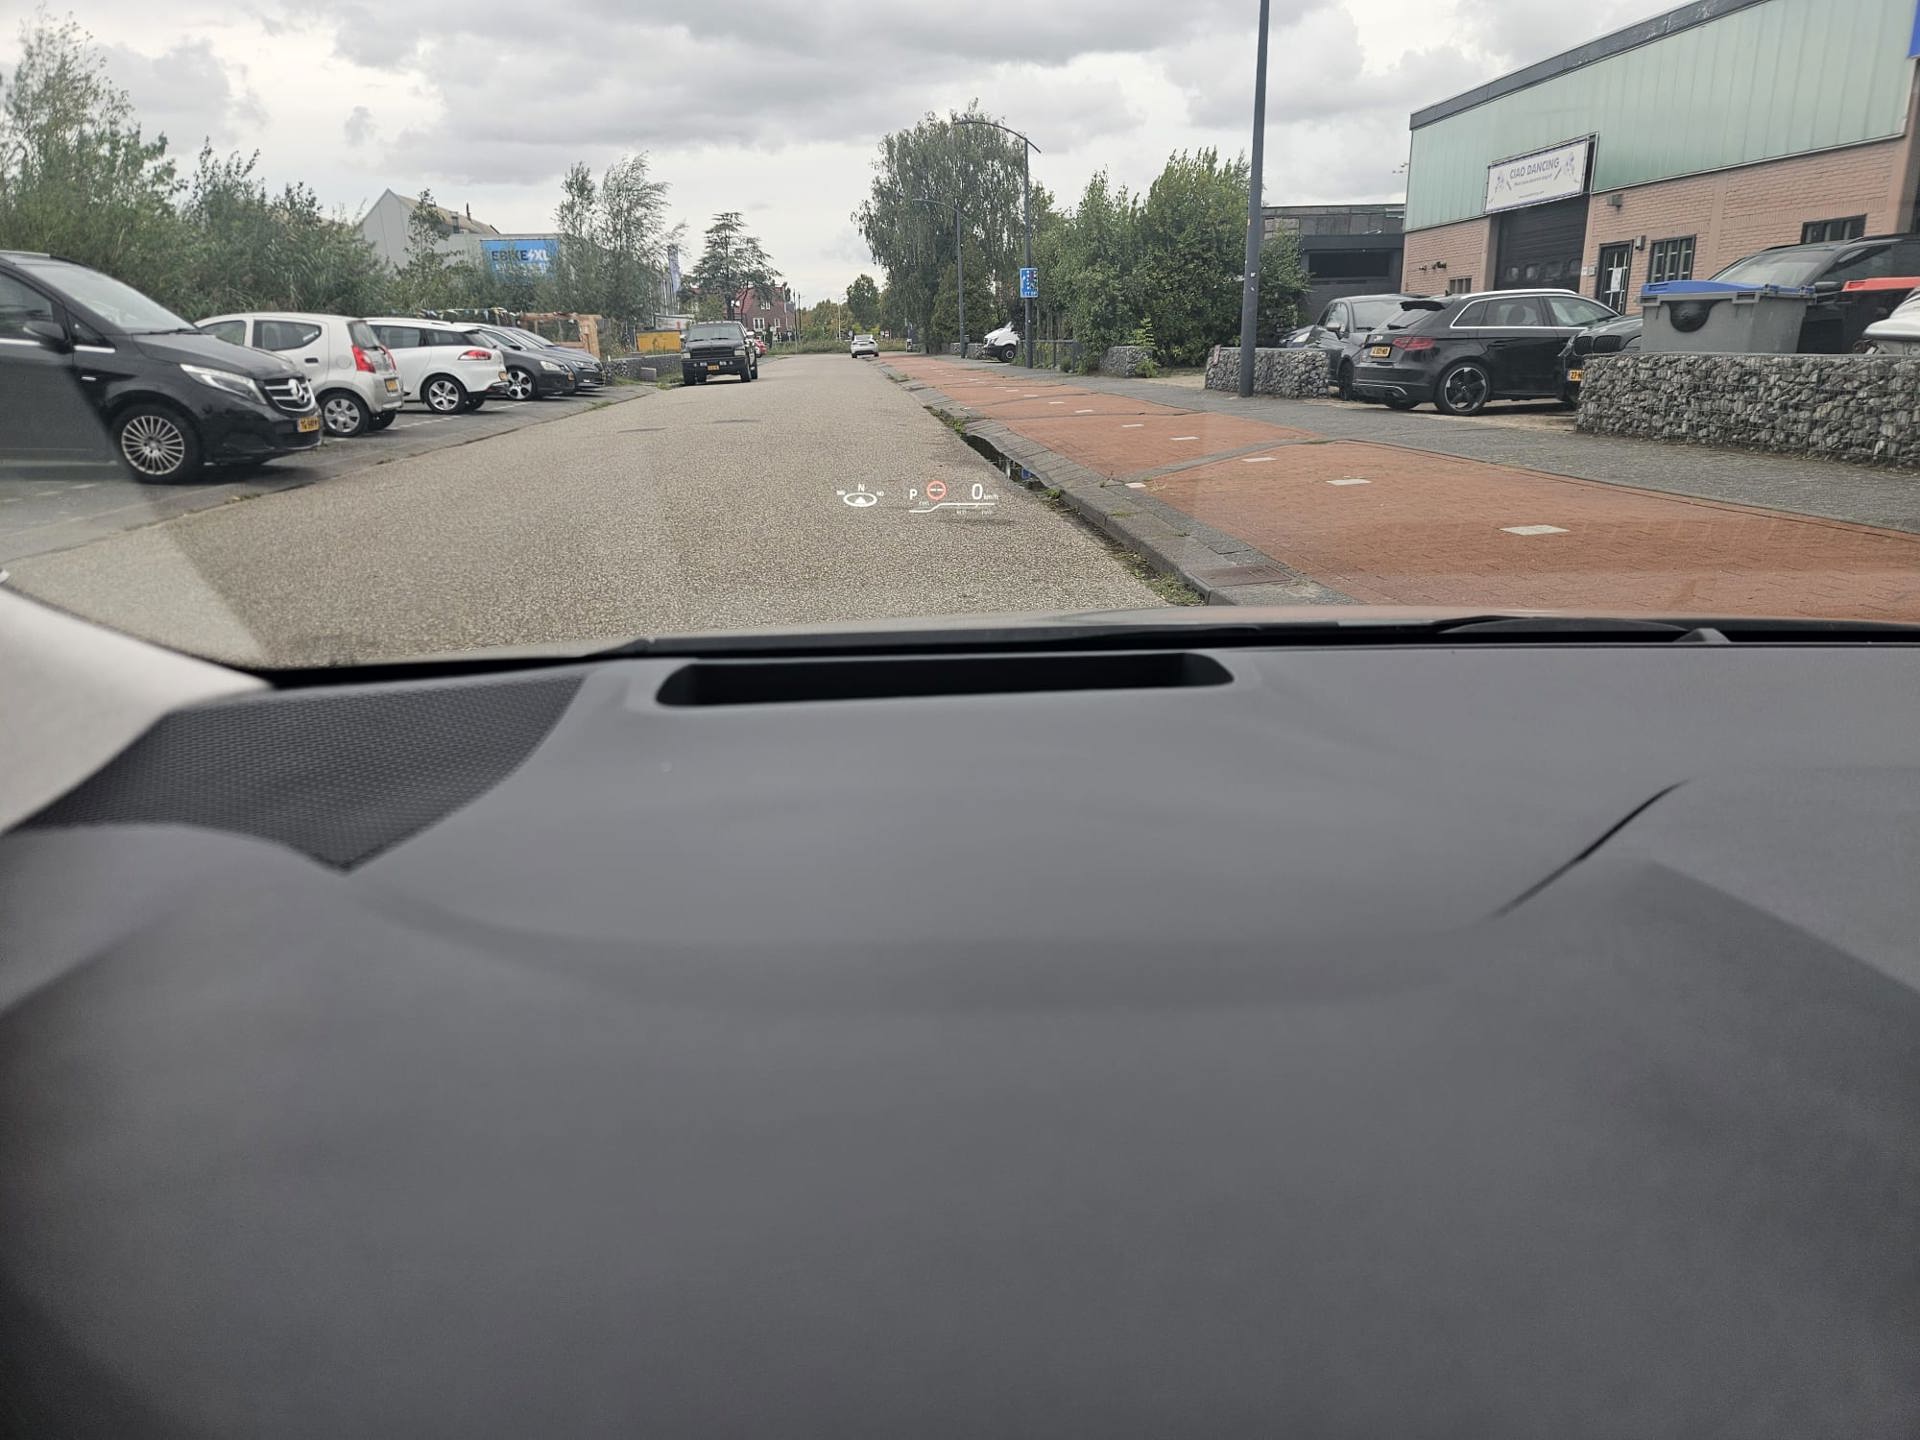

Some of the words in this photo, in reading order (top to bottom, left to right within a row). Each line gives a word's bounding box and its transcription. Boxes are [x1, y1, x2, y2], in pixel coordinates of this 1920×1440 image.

[1527, 157, 1560, 174] DANCING
[857, 483, 866, 492] N
[909, 488, 918, 500] P
[971, 483, 983, 500] 0
